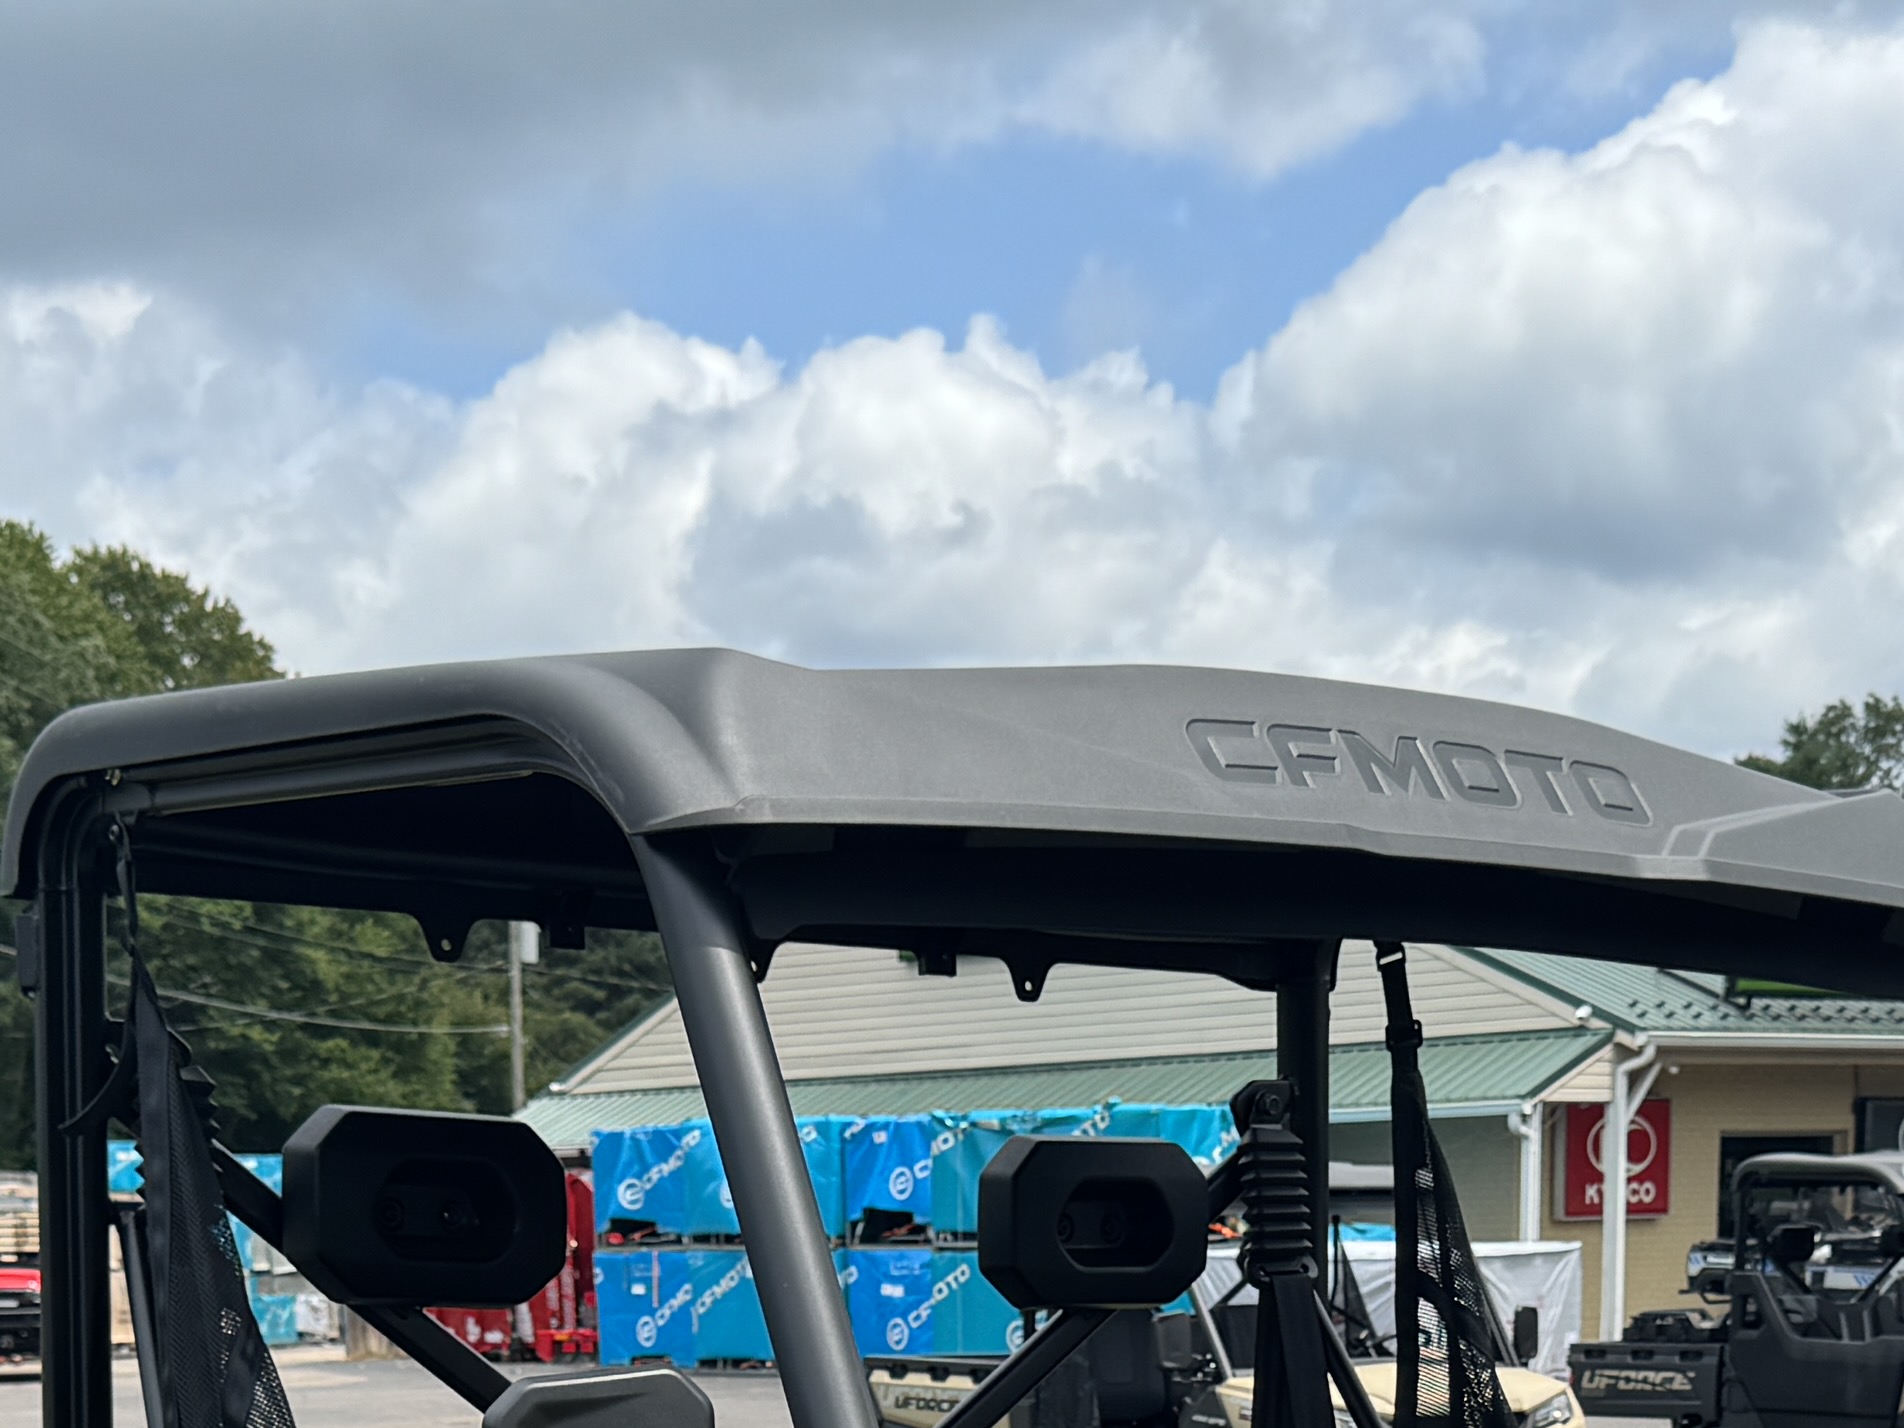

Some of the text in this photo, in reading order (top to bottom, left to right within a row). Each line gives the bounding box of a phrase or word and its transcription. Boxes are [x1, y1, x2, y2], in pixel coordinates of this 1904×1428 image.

[1183, 717, 1655, 828] CFMOTO
[1584, 1181, 1657, 1205] KCO
[695, 1255, 750, 1316] CFMO
